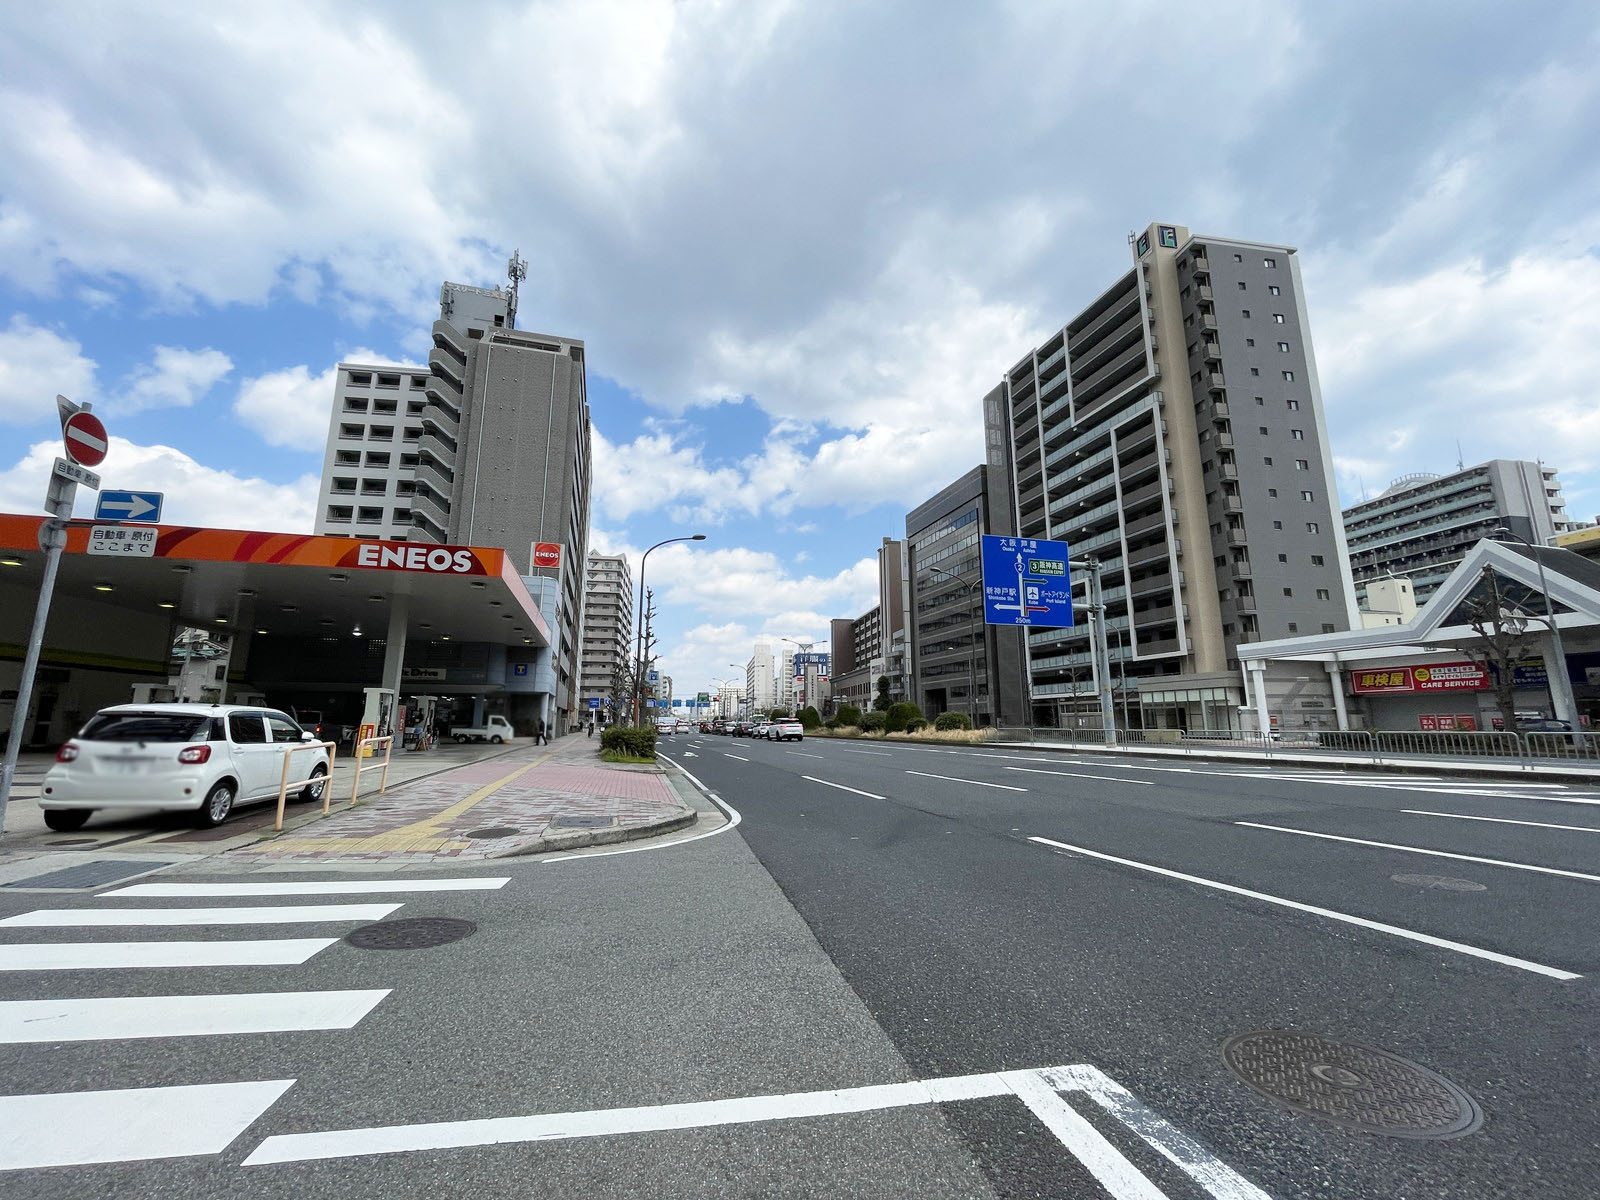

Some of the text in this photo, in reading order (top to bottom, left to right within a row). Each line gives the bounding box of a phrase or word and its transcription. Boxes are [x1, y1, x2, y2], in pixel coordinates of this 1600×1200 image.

[94, 542, 149, 552] ここまで
[1000, 539, 1037, 548] 大阪 芦屋
[358, 544, 472, 572] ENEOS
[1040, 561, 1063, 570] 阪神高速
[986, 587, 1017, 596] 新神戸駅
[1361, 672, 1404, 687] 車検屋
